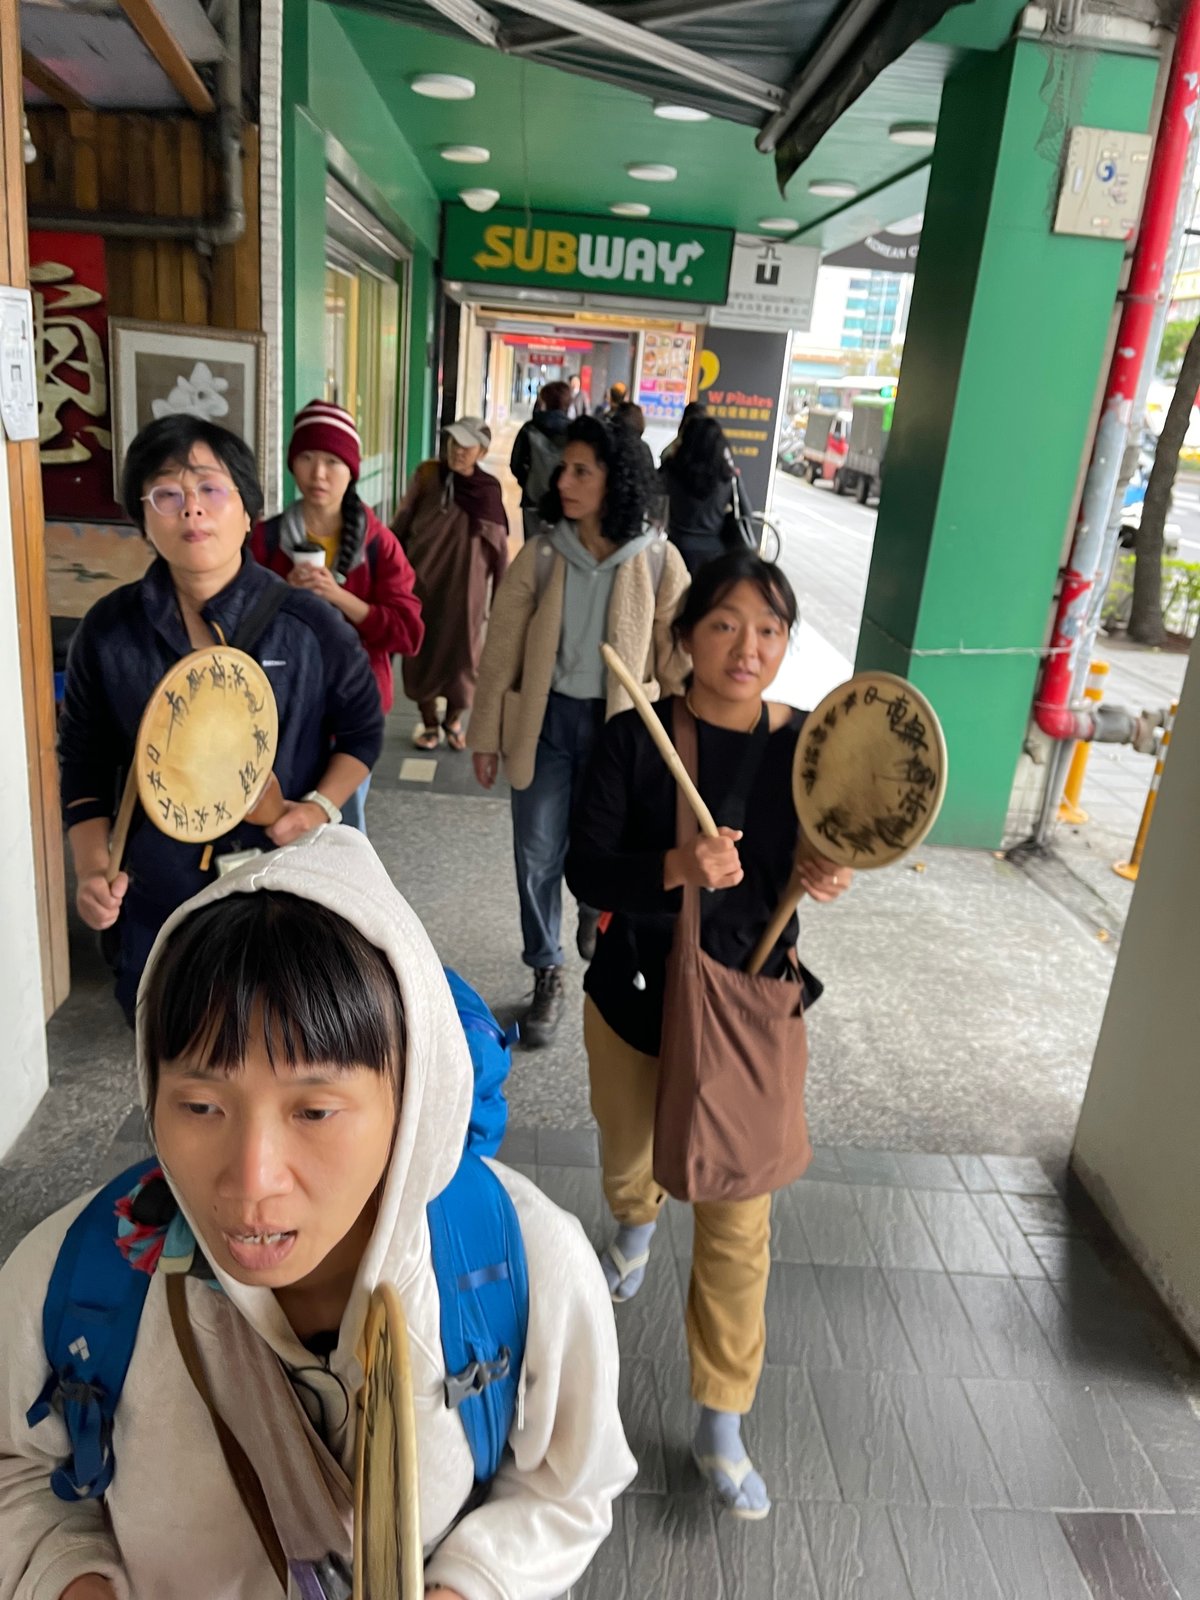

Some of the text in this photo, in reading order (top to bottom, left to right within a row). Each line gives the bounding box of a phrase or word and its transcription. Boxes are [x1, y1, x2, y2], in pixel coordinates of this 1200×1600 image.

[473, 225, 704, 286] SUBWAY
[707, 390, 774, 408] W Pilates
